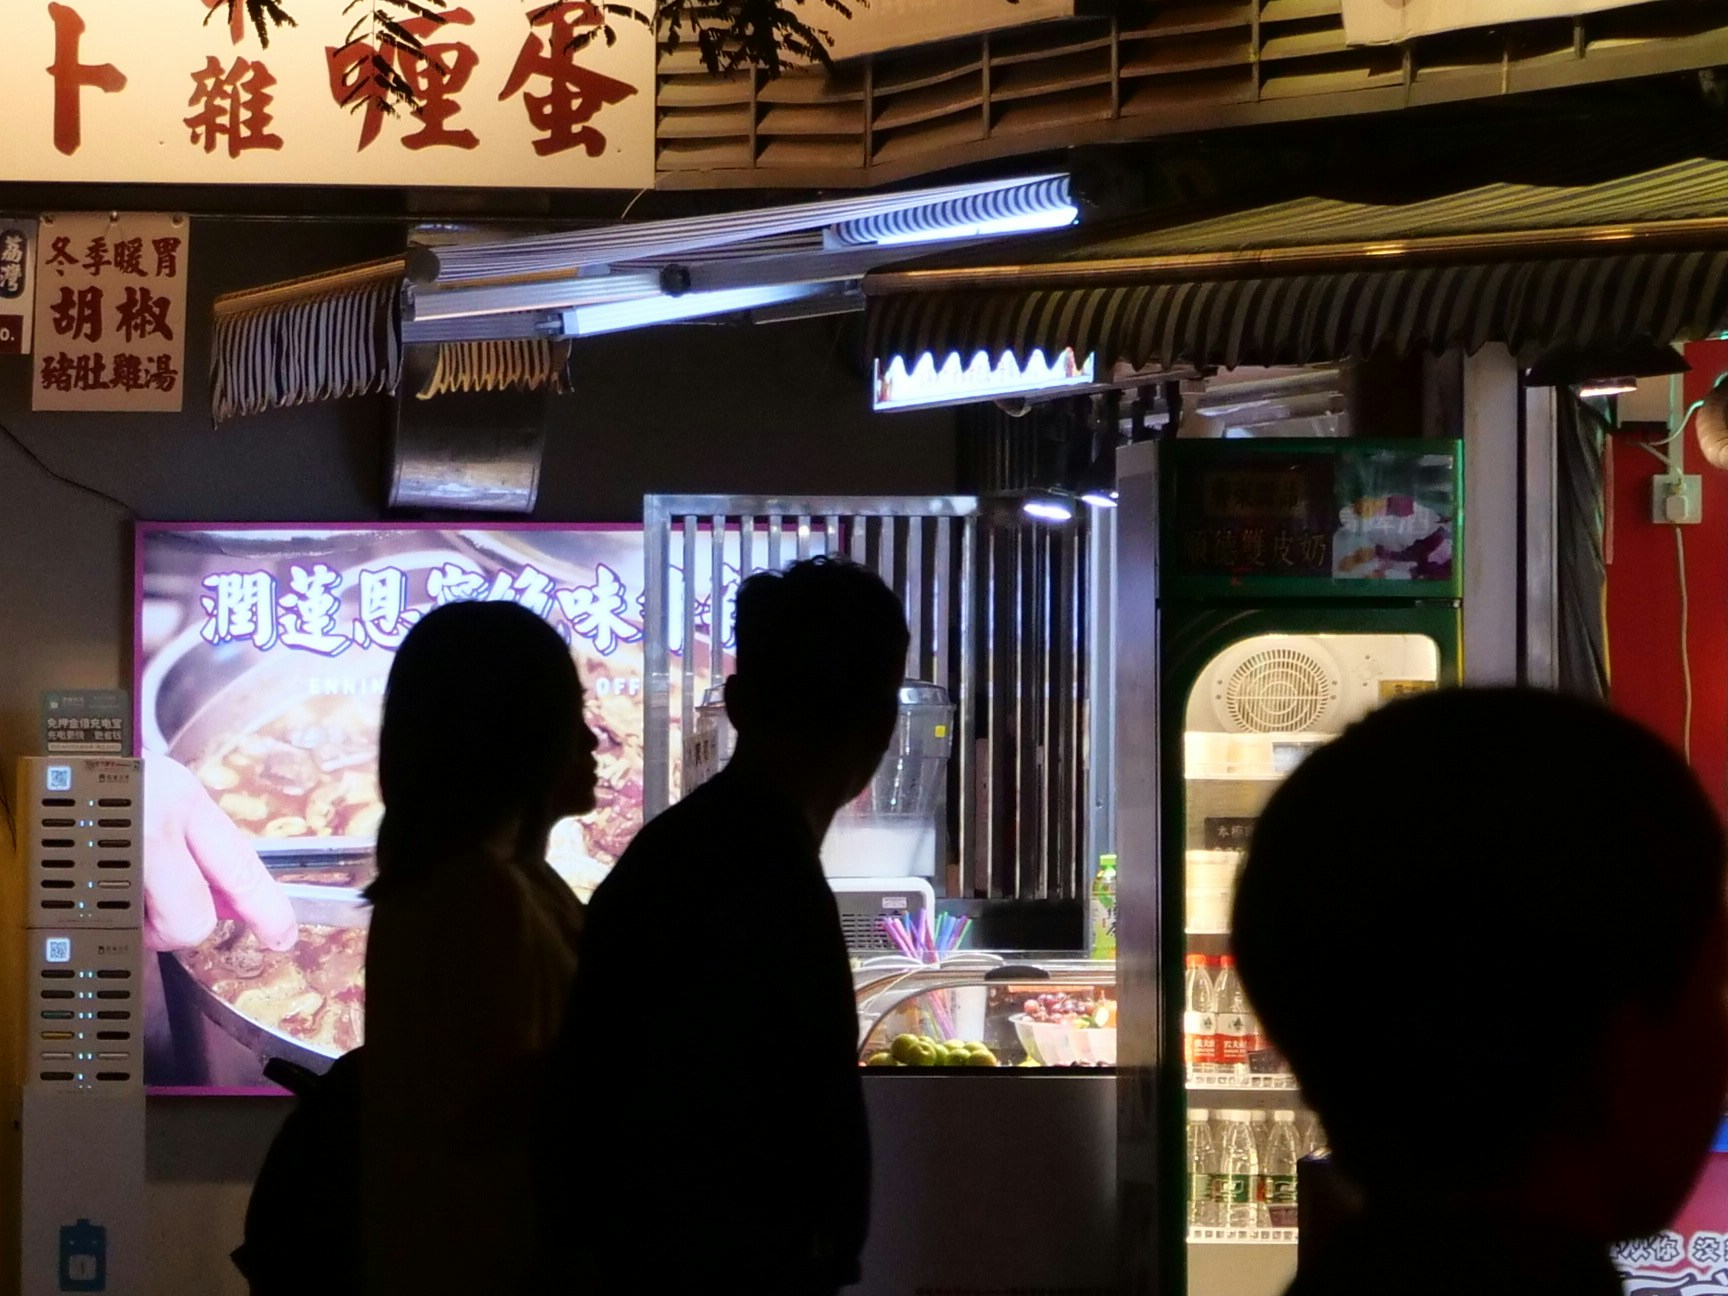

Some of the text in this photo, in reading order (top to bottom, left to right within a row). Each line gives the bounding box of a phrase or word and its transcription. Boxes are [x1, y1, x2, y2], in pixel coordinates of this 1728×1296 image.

[45, 235, 182, 278] 冬季暖胃
[50, 285, 174, 344] 胡椒
